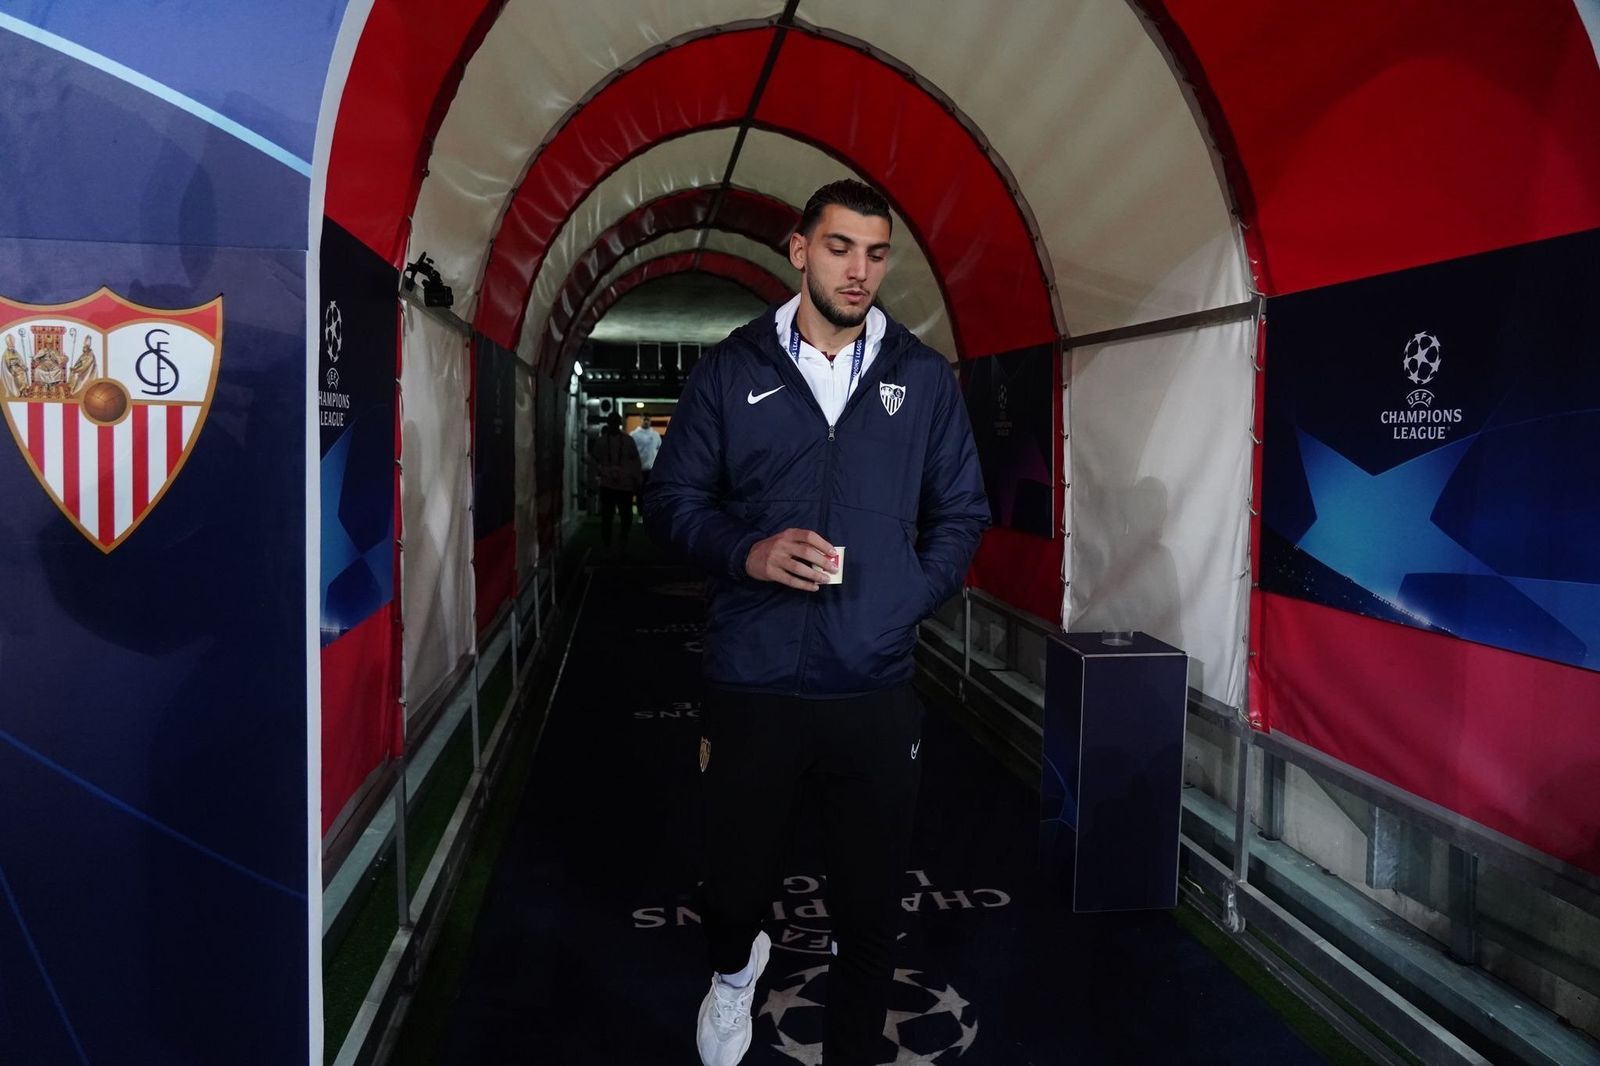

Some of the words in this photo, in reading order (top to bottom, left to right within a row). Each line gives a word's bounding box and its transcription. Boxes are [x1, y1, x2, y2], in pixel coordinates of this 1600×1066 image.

[318, 391, 350, 409] HAMPIONS
[1407, 392, 1432, 405] UEFA
[320, 411, 344, 427] LEAGUE
[1380, 408, 1462, 424] CHAMPIONS
[1393, 426, 1446, 440] LEAGUE
